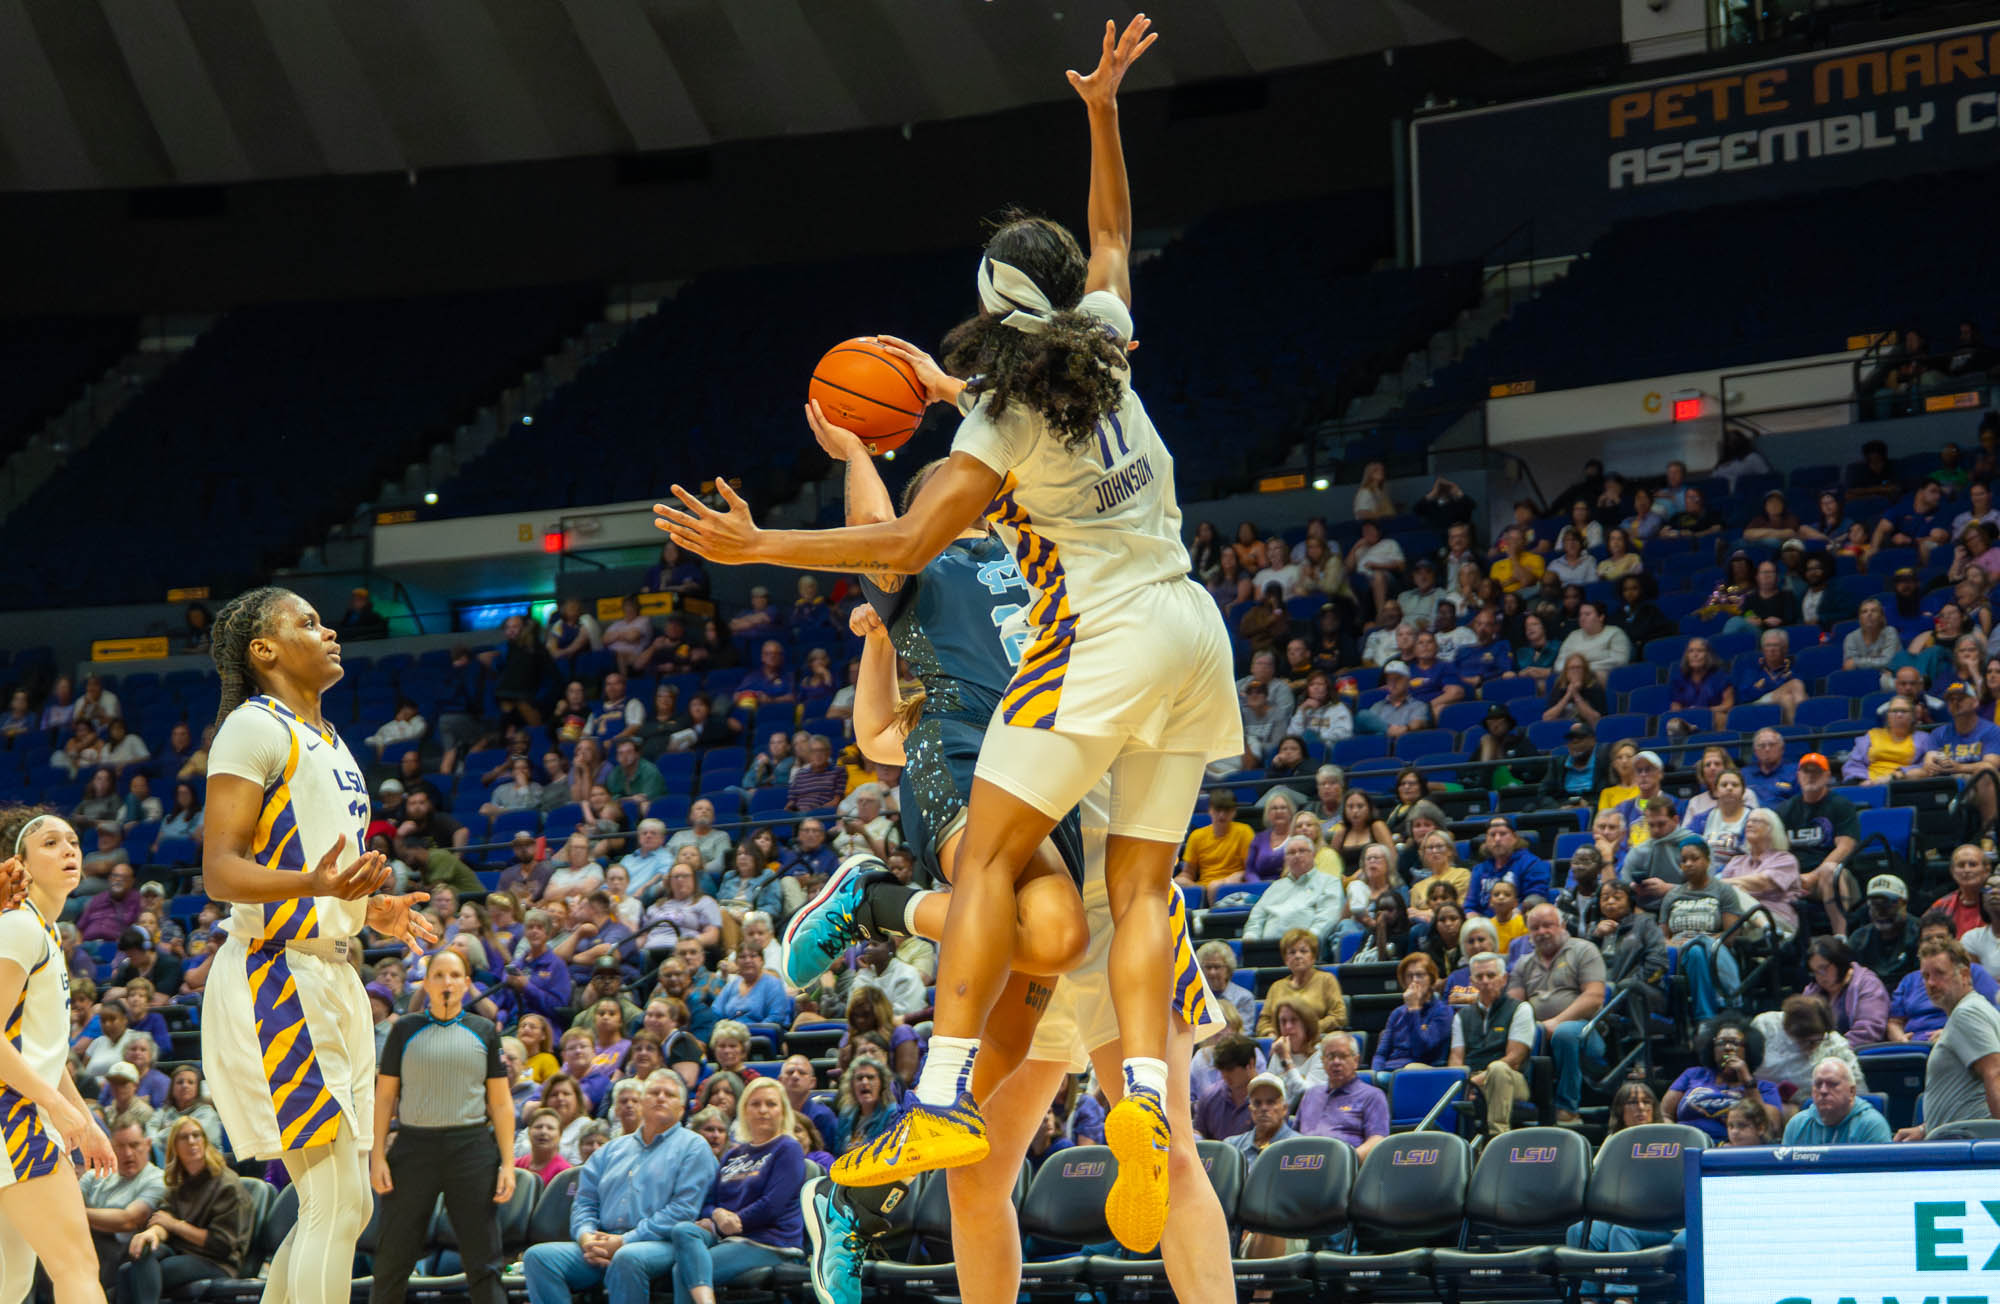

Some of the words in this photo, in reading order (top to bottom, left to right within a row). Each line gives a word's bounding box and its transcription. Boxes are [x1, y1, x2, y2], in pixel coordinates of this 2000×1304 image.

[1609, 68, 1790, 138] PETE
[1609, 101, 1936, 189] ASSEMBLY
[1956, 91, 2000, 134] C
[1094, 452, 1154, 513] JOHNSON
[1787, 826, 1822, 842] LSU
[1392, 1149, 1438, 1165] LSU
[1510, 1147, 1557, 1163] LSU
[1632, 1143, 1680, 1159] LSU
[1062, 1162, 1105, 1177] LSU
[1280, 1154, 1324, 1170] LSU
